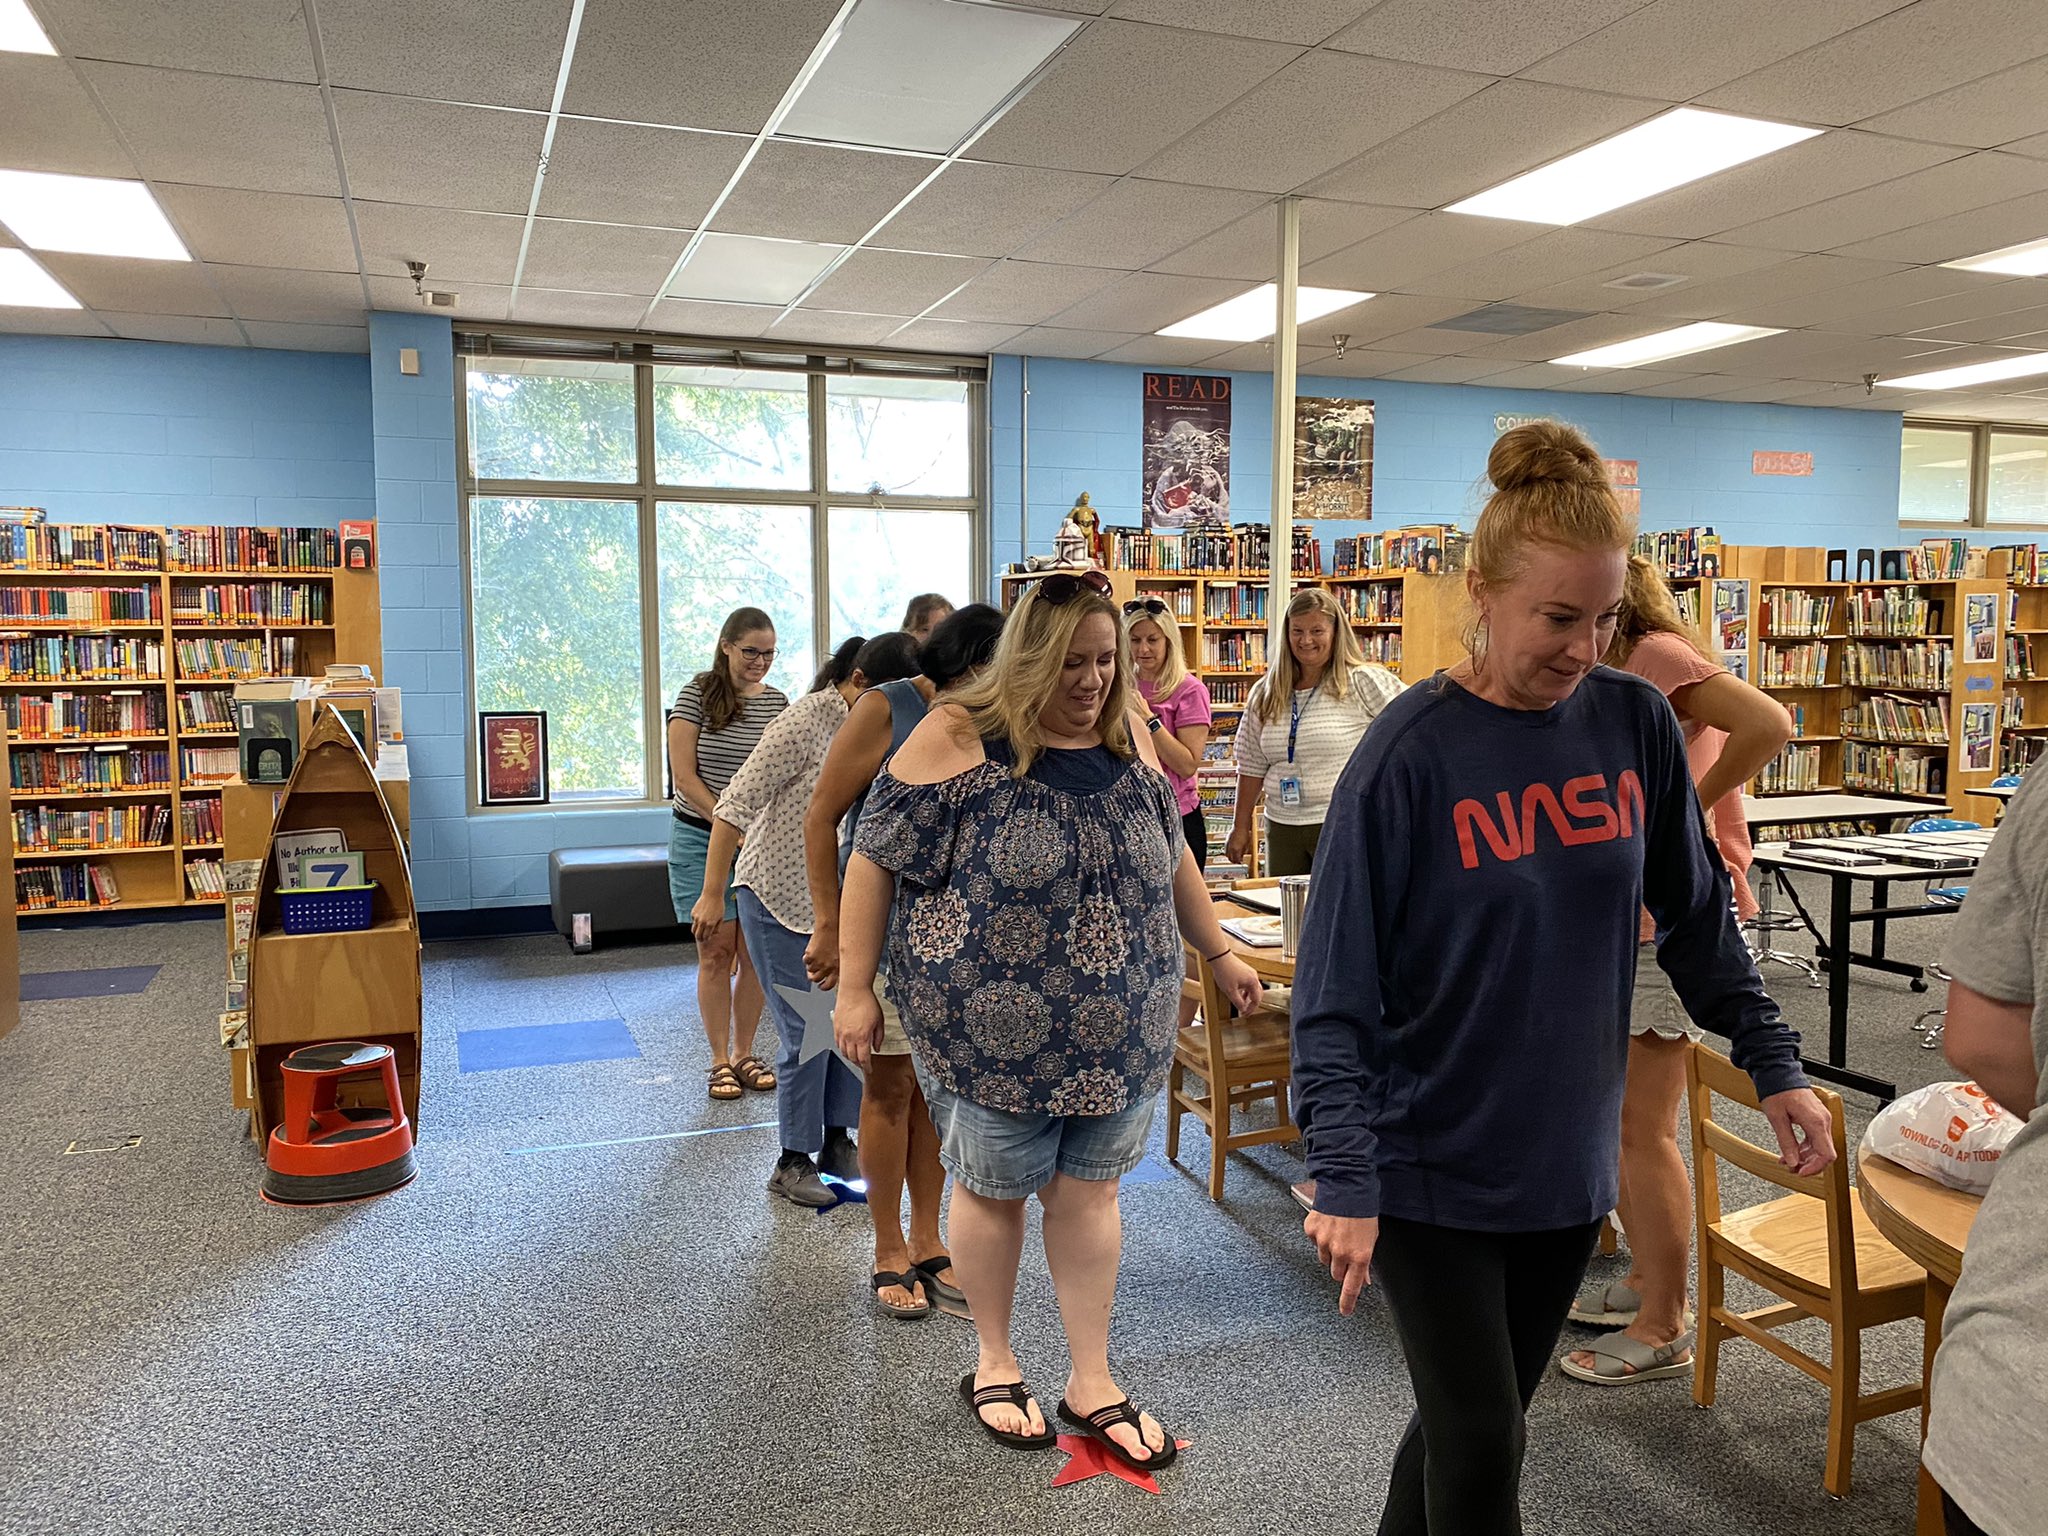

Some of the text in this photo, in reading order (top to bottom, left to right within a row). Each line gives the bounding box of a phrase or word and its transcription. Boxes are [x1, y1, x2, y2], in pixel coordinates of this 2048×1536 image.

[1146, 375, 1229, 399] READ
[1453, 769, 1645, 869] NASA
[280, 845, 340, 859] No Author or
[311, 863, 349, 887] 7
